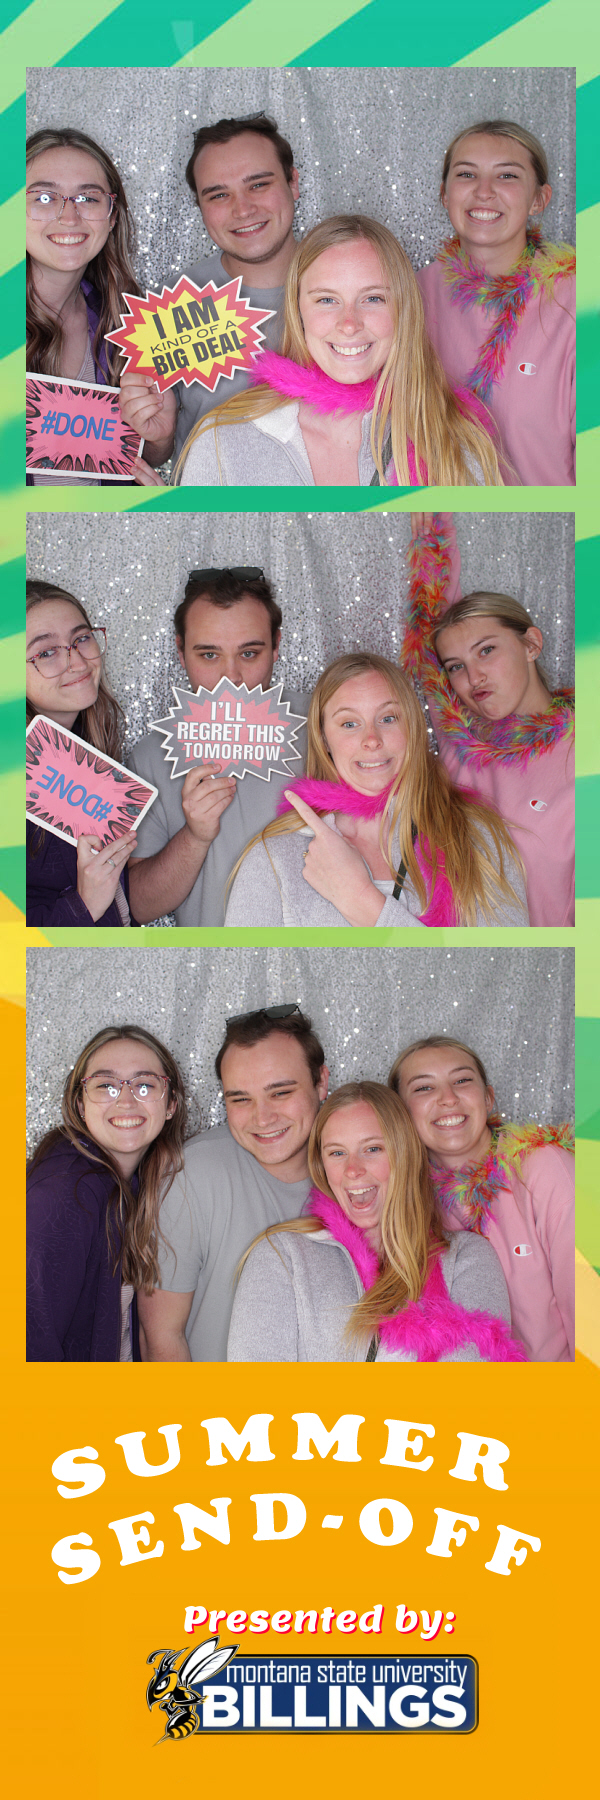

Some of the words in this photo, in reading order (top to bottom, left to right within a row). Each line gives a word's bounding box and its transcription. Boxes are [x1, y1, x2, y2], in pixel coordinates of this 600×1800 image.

[152, 313, 166, 340] I
[171, 295, 220, 334] AM
[150, 334, 192, 354] KIND
[196, 323, 219, 339] OF
[225, 320, 238, 330] A
[151, 348, 190, 377] BIG
[193, 330, 247, 364] DEAL
[40, 410, 117, 441] #DONE
[210, 701, 246, 723] I'LL
[176, 721, 243, 743] REGRET
[246, 722, 286, 744] THIS
[183, 742, 281, 761] TOMORROW
[35, 765, 114, 823] #DONE
